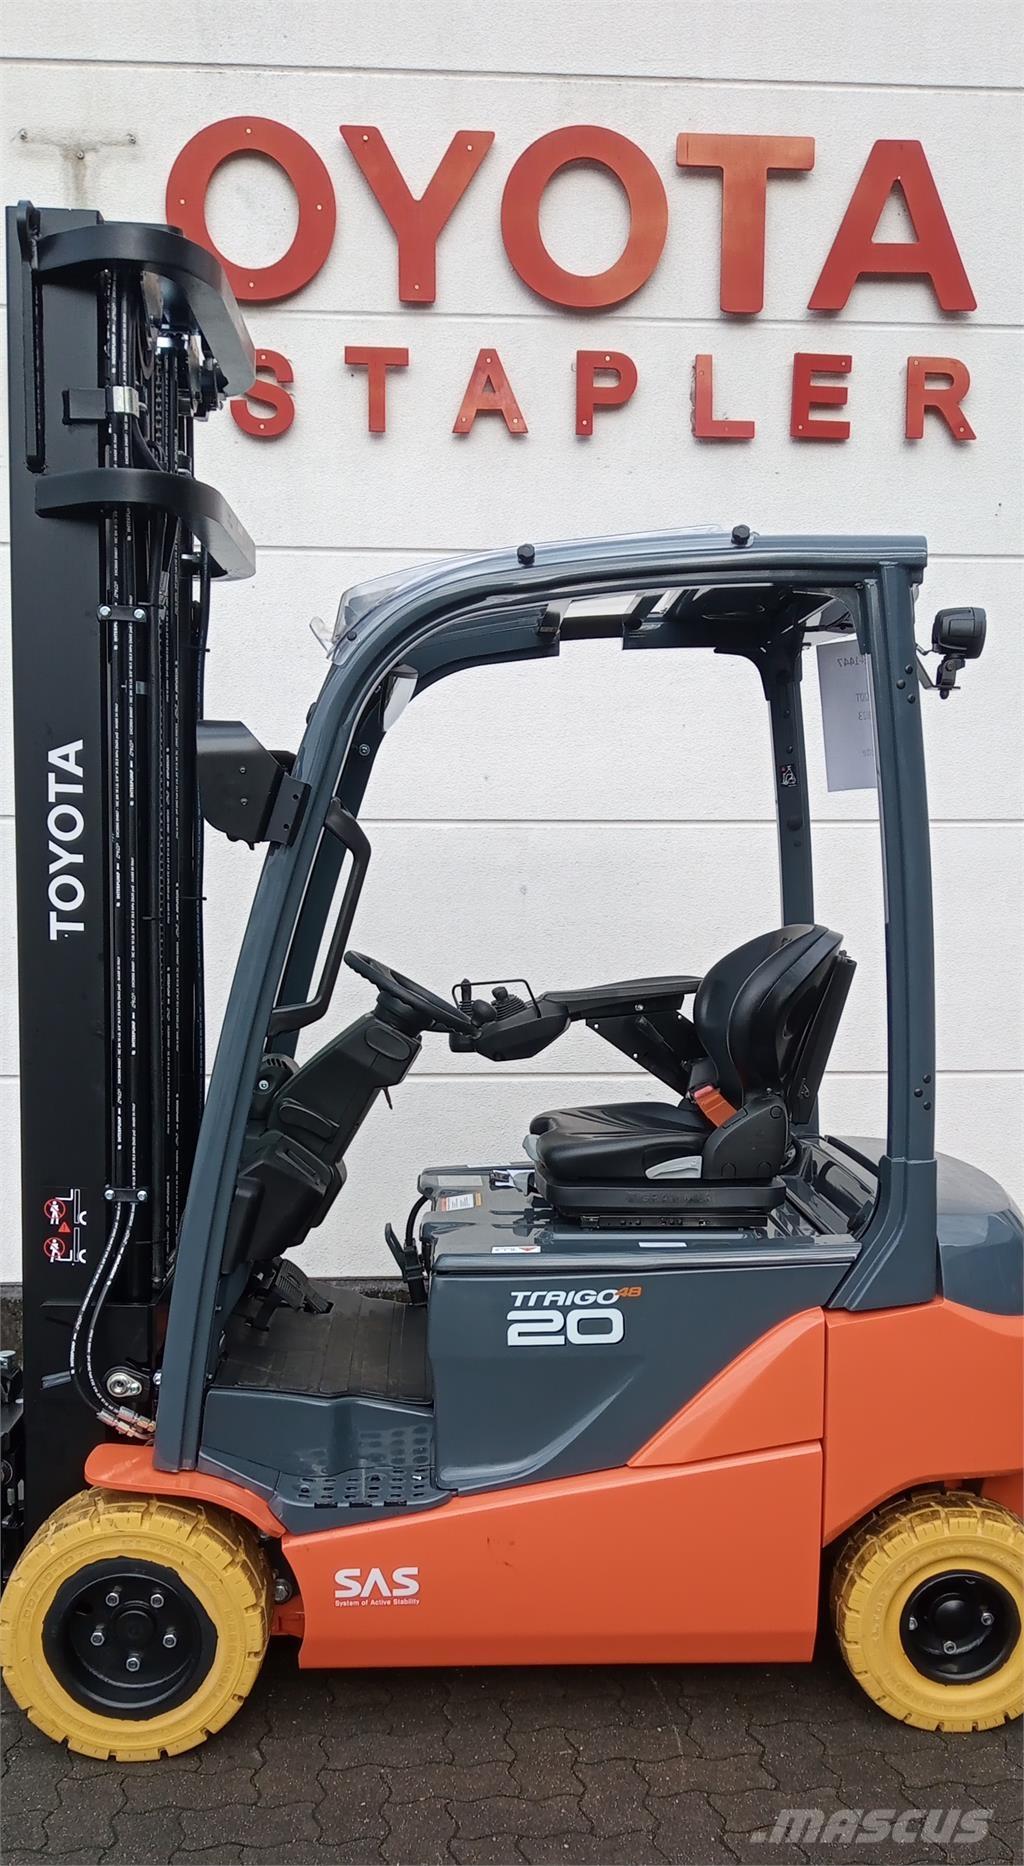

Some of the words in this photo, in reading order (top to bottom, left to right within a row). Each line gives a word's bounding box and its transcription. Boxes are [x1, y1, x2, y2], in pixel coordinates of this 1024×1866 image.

[230, 345, 977, 442] STAPLER
[47, 739, 85, 940] TOYOTA
[506, 1308, 625, 1346] 20
[335, 1567, 420, 1598] SAS
[335, 1599, 360, 1607] System
[370, 1598, 391, 1606] Active
[393, 1598, 420, 1606] Stability
